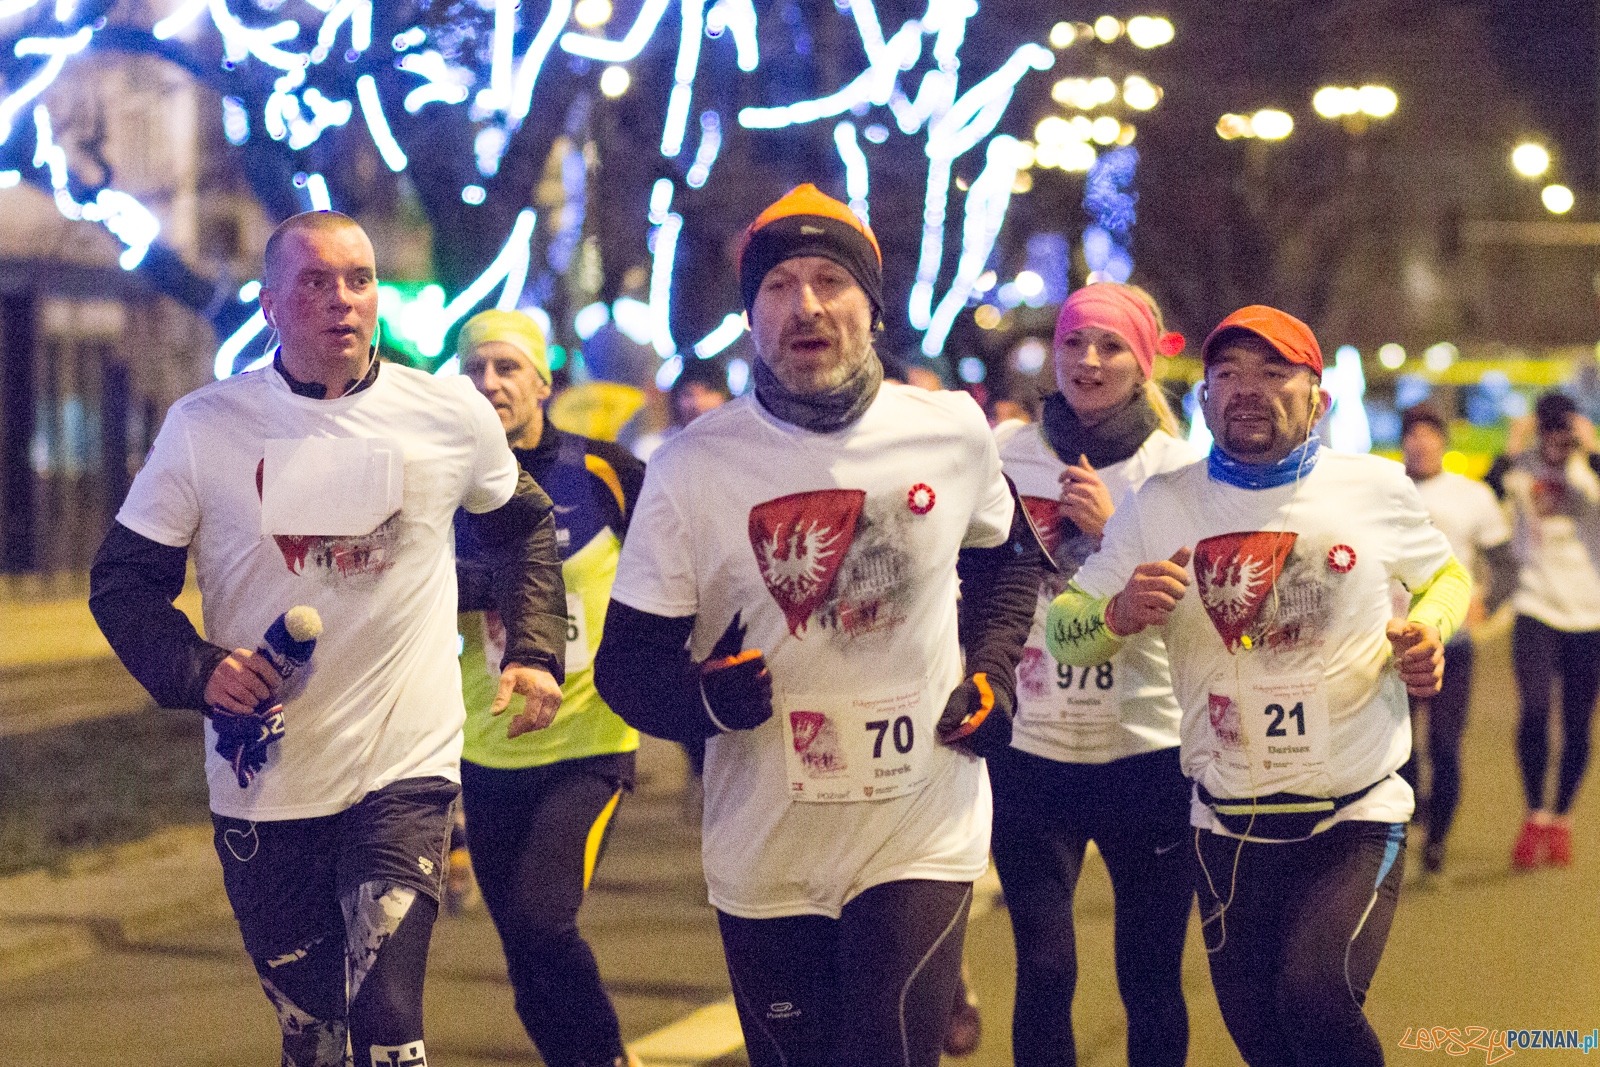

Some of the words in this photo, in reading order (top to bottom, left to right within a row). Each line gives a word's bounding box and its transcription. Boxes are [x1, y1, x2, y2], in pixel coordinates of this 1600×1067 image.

[1057, 660, 1114, 690] 978
[1264, 701, 1306, 737] 21
[865, 715, 915, 759] 70
[1267, 745, 1311, 754] Dariusz
[874, 764, 912, 779] Darek
